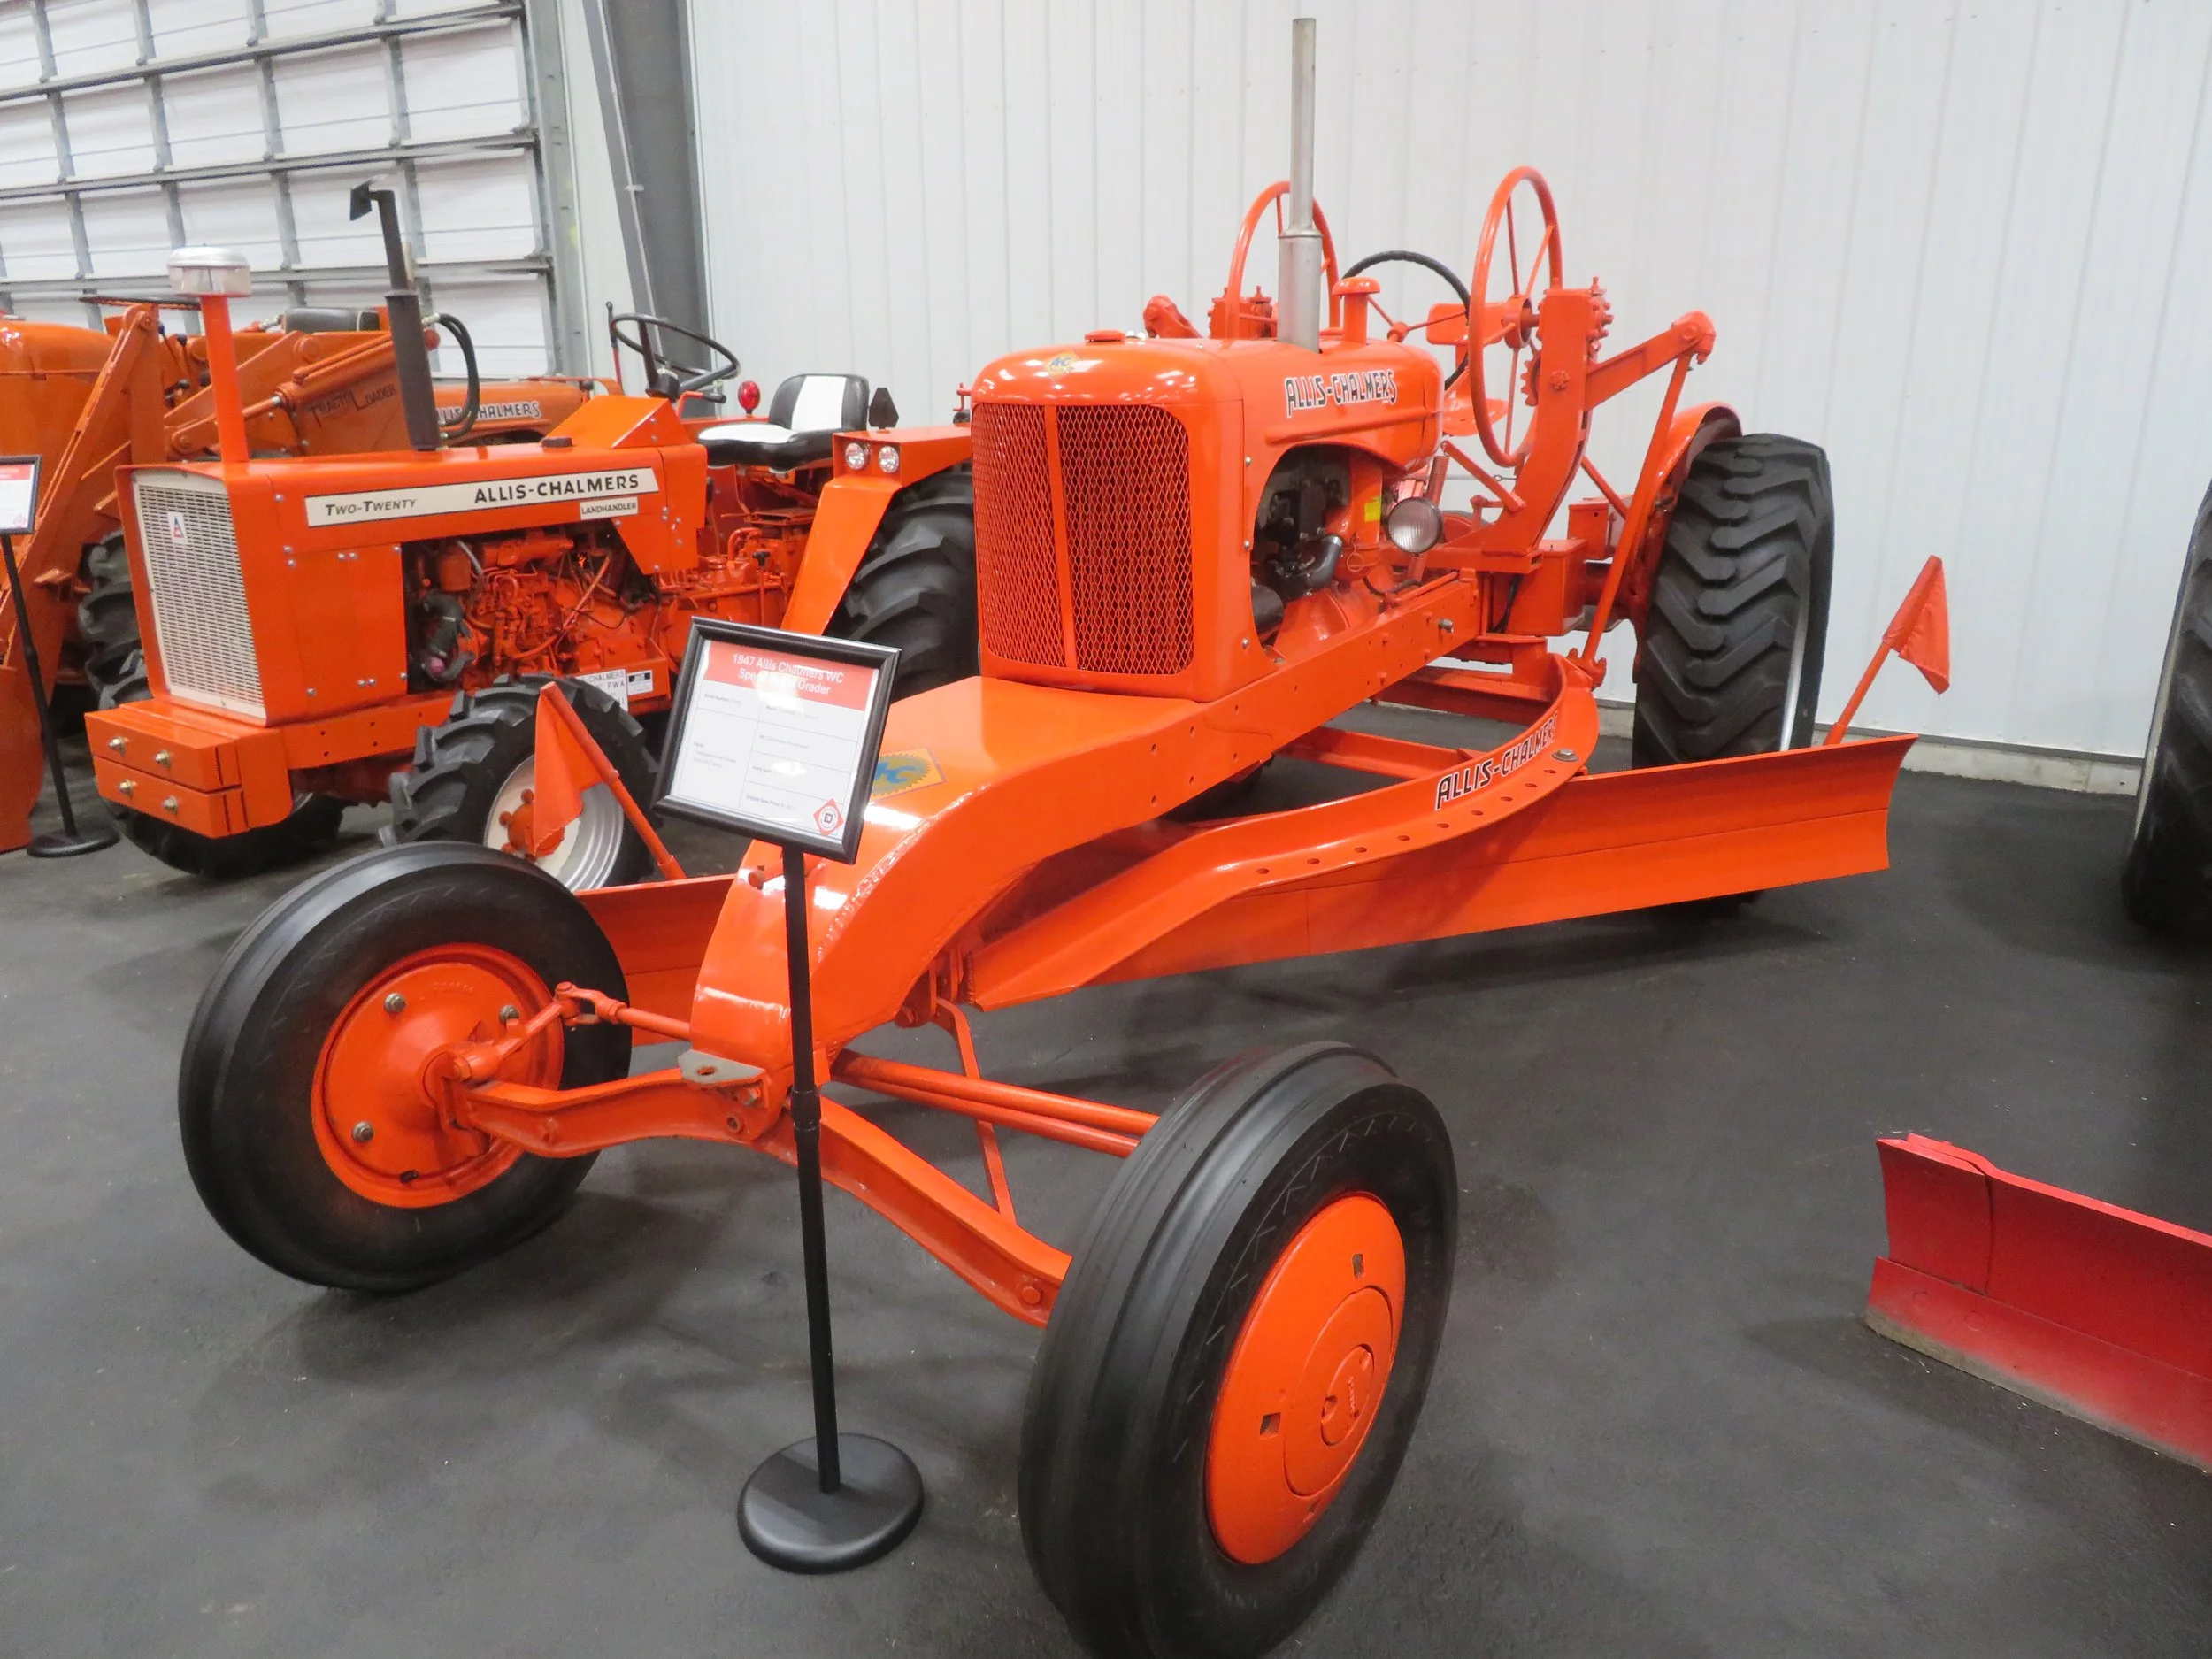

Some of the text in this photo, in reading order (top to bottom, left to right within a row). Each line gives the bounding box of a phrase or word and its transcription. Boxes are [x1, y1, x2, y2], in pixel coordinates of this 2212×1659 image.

[1285, 369, 1396, 418] ALLIS-CHALMERS
[474, 474, 639, 503] ALLIS-CHALMERS
[581, 502, 637, 515] LANDHANDLER
[733, 654, 754, 666] 1947
[757, 657, 777, 671] Allis
[825, 670, 845, 684] WC
[797, 679, 830, 695] Grader
